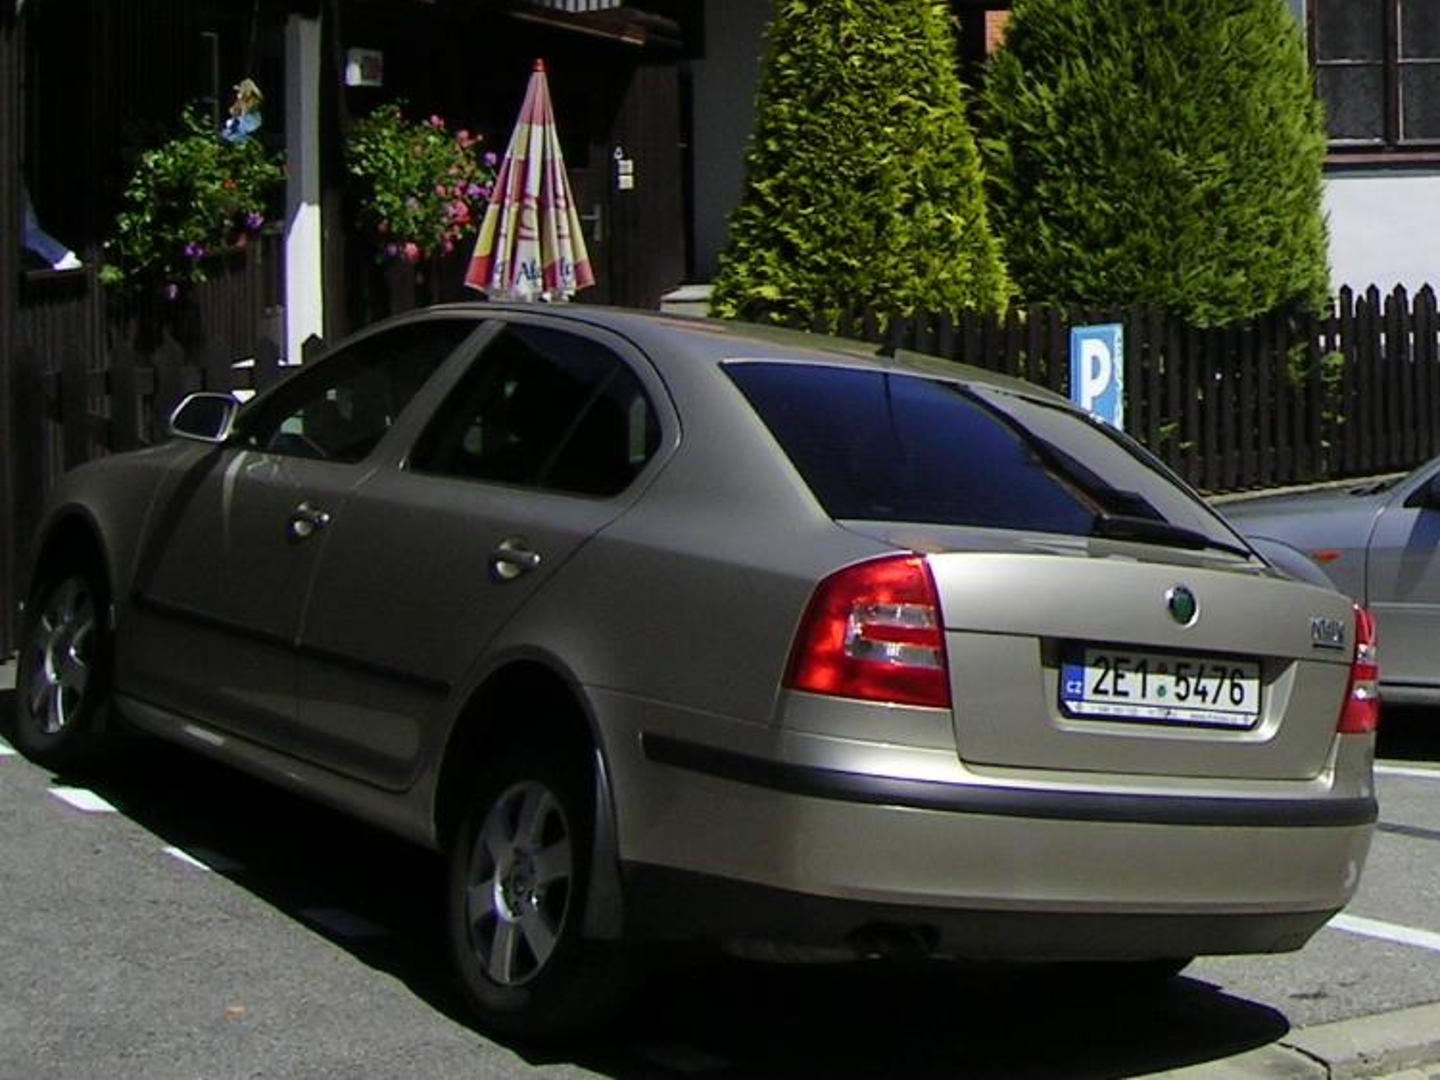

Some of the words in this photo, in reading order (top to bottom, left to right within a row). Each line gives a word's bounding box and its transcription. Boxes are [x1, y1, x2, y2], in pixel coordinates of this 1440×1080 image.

[1080, 338, 1111, 410] P
[1066, 681, 1082, 695] CZ
[1092, 655, 1148, 699] 2E1
[1174, 662, 1245, 706] 5476
